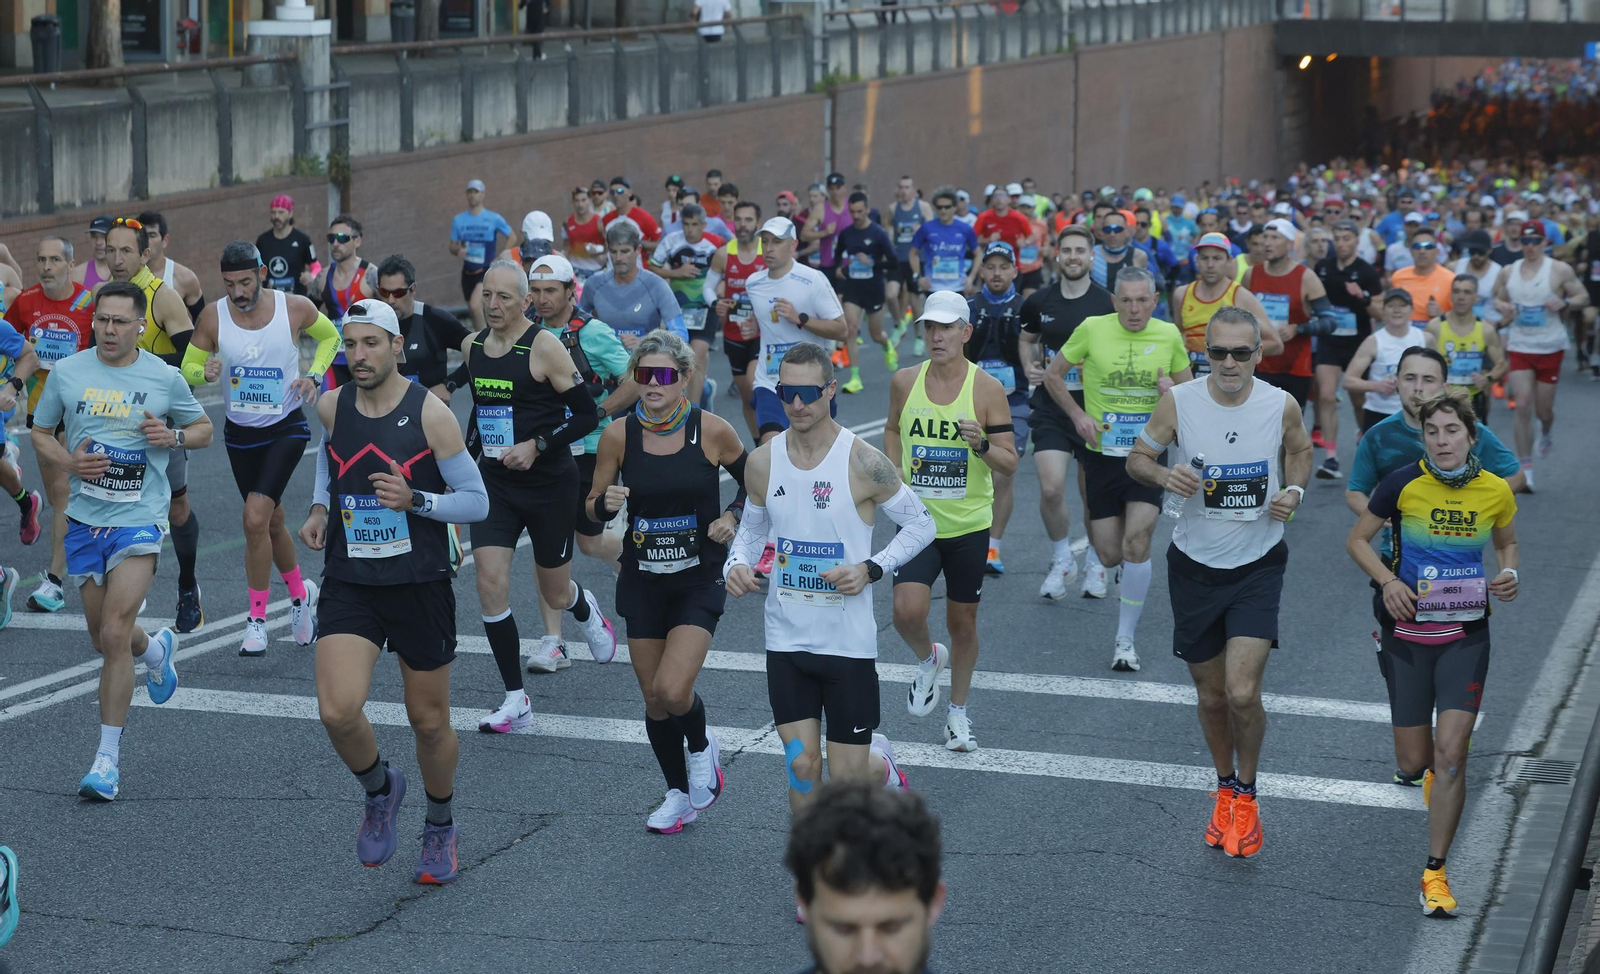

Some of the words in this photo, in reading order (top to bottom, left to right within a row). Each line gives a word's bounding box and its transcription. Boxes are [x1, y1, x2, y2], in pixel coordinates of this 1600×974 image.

[46, 331, 71, 340] ZURICH
[248, 369, 278, 377] ZURICH
[239, 391, 274, 403] DANIEL
[909, 418, 965, 442] ALEX
[108, 449, 141, 460] ZURICH
[929, 450, 961, 458] ZURICH
[929, 465, 947, 473] 3172
[1226, 465, 1262, 476] ZURICH
[911, 474, 967, 487] ALEXANDRE
[1227, 484, 1248, 493] 3325
[359, 499, 381, 507] ZUR
[1219, 494, 1257, 507] JOKIN
[363, 516, 381, 526] 4630
[1431, 508, 1478, 526] CEJ
[653, 519, 689, 529] ZURICH
[354, 526, 397, 542] DELPUY
[655, 537, 676, 546] 3329
[646, 546, 688, 560] MARIA
[797, 545, 835, 555] ZURICH
[798, 563, 817, 573] 4821
[1442, 567, 1478, 577] ZURICH
[782, 573, 795, 587] EL
[1443, 586, 1462, 594] 9651
[1418, 602, 1447, 611] SONIA
[1449, 600, 1487, 610] BASSAS
